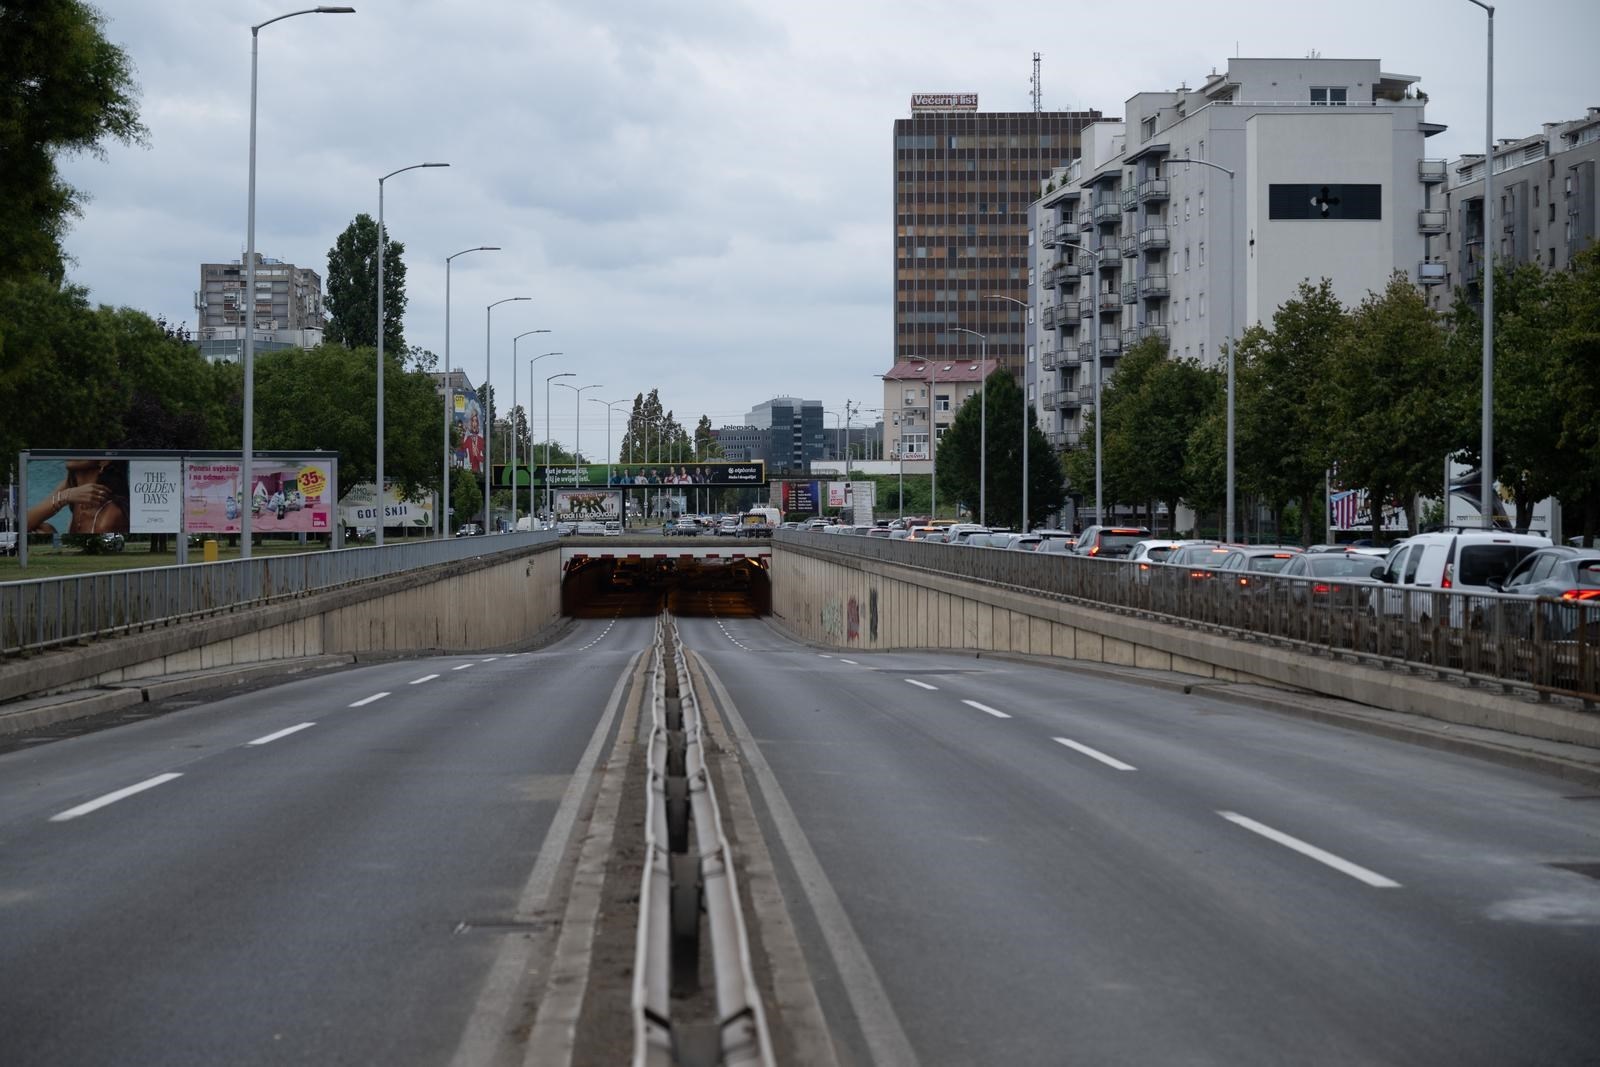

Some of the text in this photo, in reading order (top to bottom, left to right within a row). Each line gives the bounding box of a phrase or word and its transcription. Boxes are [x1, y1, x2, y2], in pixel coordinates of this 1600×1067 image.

[914, 96, 977, 106] Večernji list
[144, 472, 166, 482] THE
[134, 483, 177, 493] GOLDEN
[143, 494, 168, 504] DAYS
